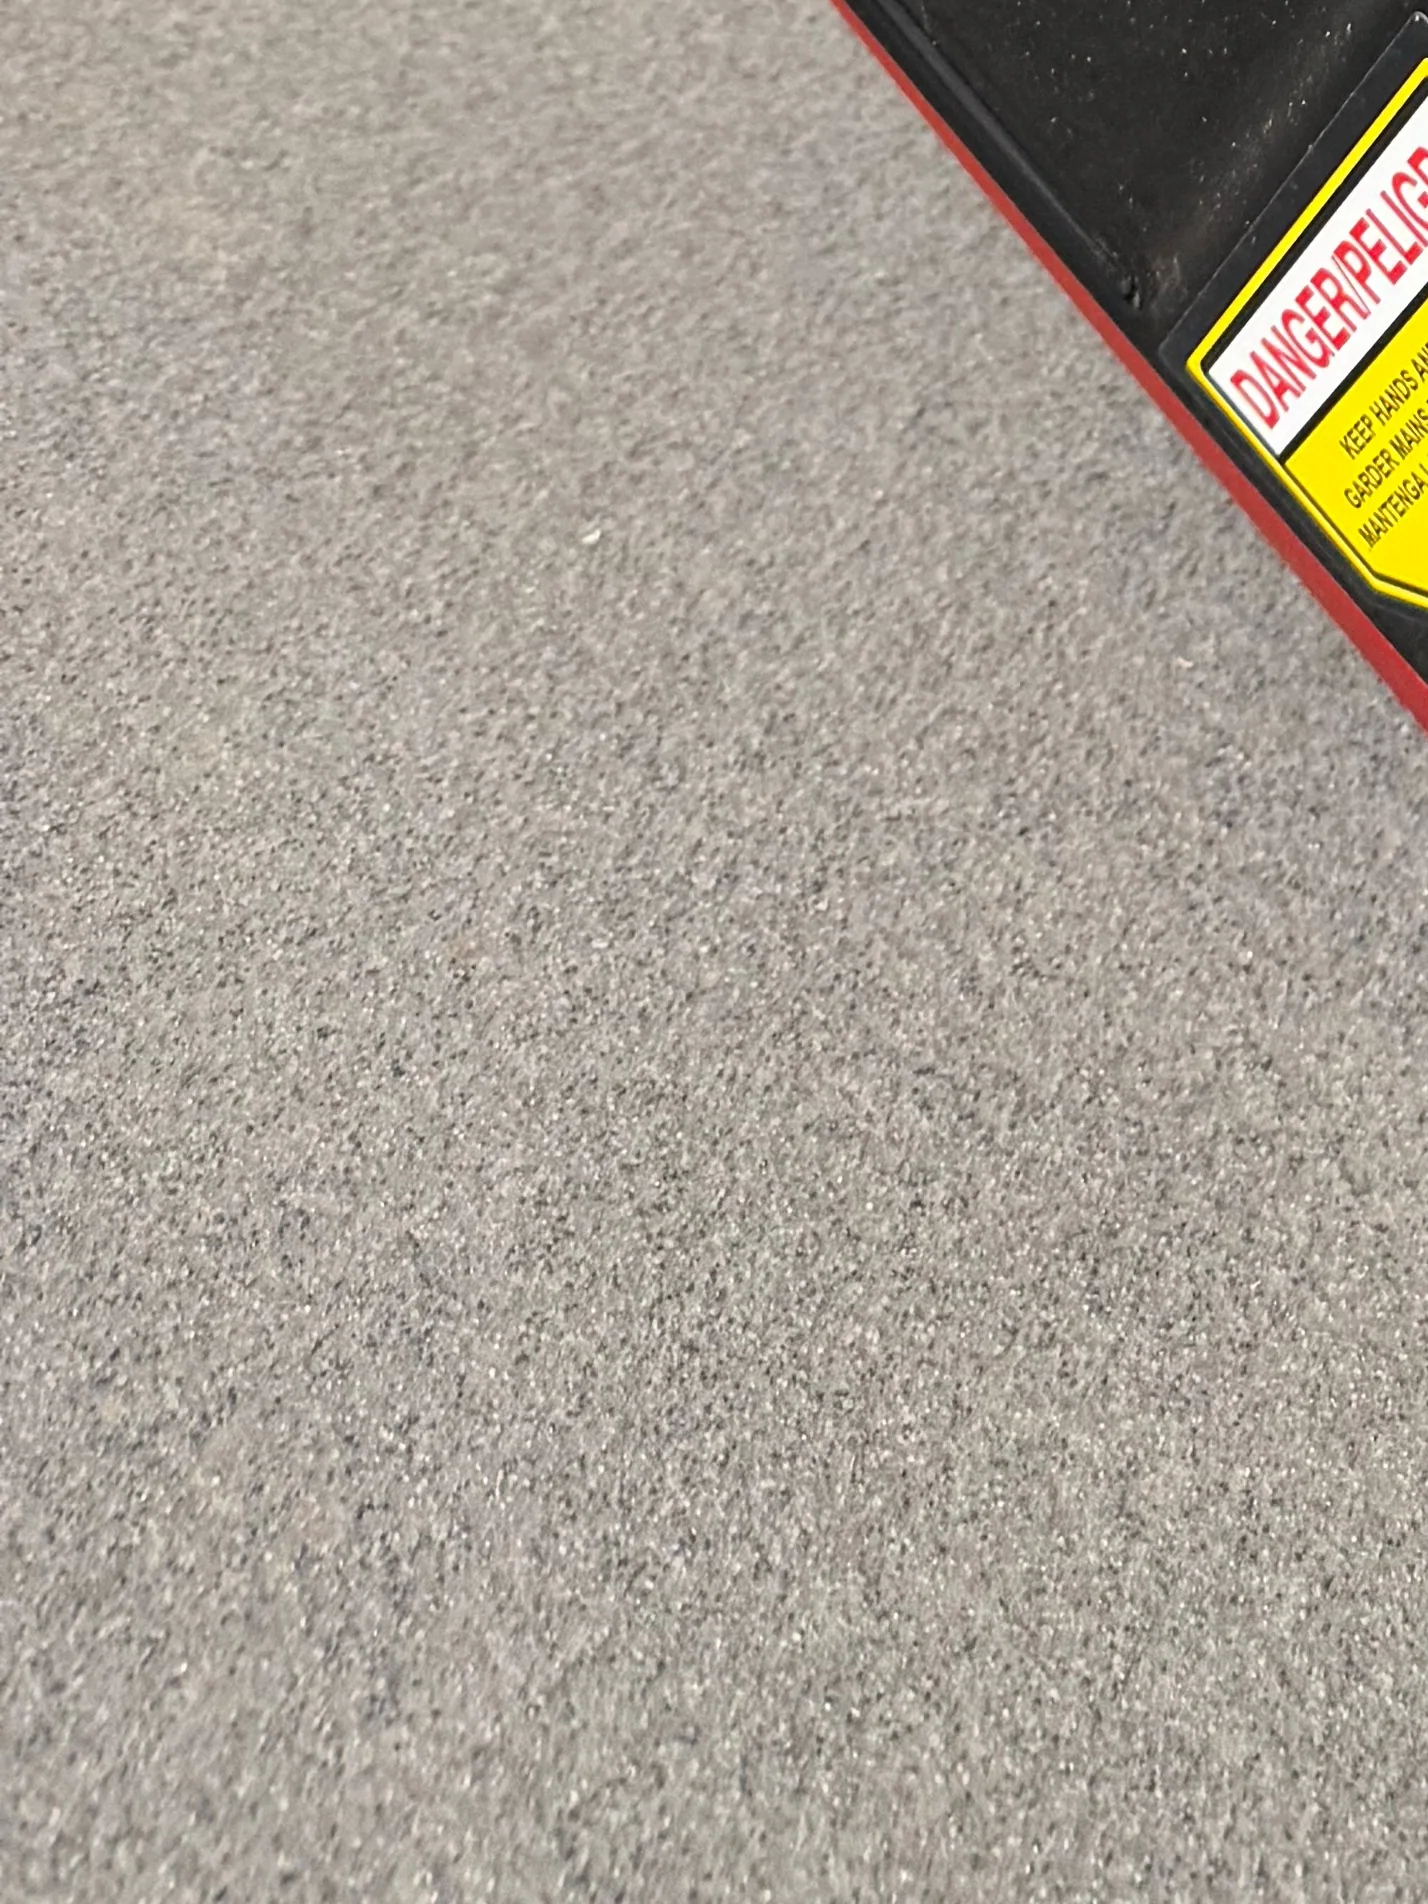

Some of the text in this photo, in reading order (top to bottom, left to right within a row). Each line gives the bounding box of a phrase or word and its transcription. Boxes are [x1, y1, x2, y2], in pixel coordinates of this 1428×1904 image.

[1339, 414, 1376, 460] KEEP
[1369, 369, 1419, 426] HANDS
[1344, 448, 1400, 509] GARDER
